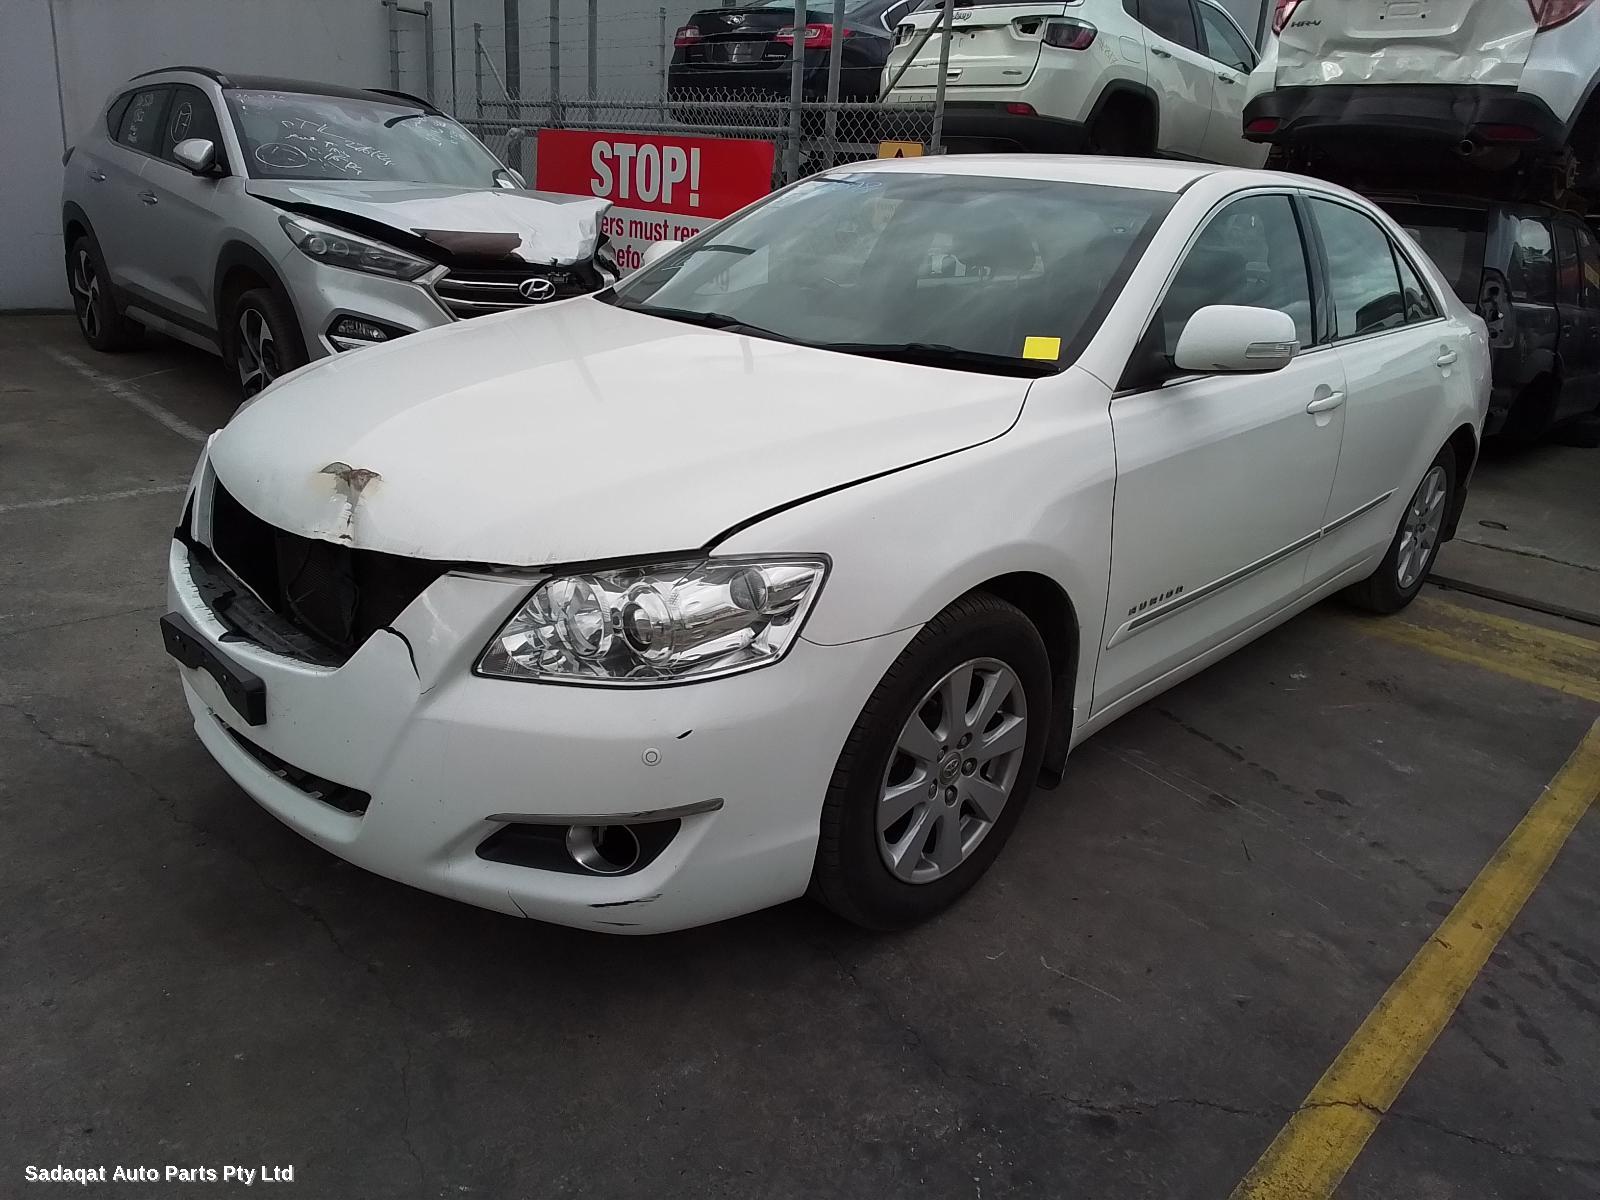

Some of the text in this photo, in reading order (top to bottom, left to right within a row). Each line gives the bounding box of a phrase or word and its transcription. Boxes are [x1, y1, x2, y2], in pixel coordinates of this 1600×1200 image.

[590, 140, 701, 208] STOP!
[629, 219, 669, 241] must
[613, 244, 644, 270] efo
